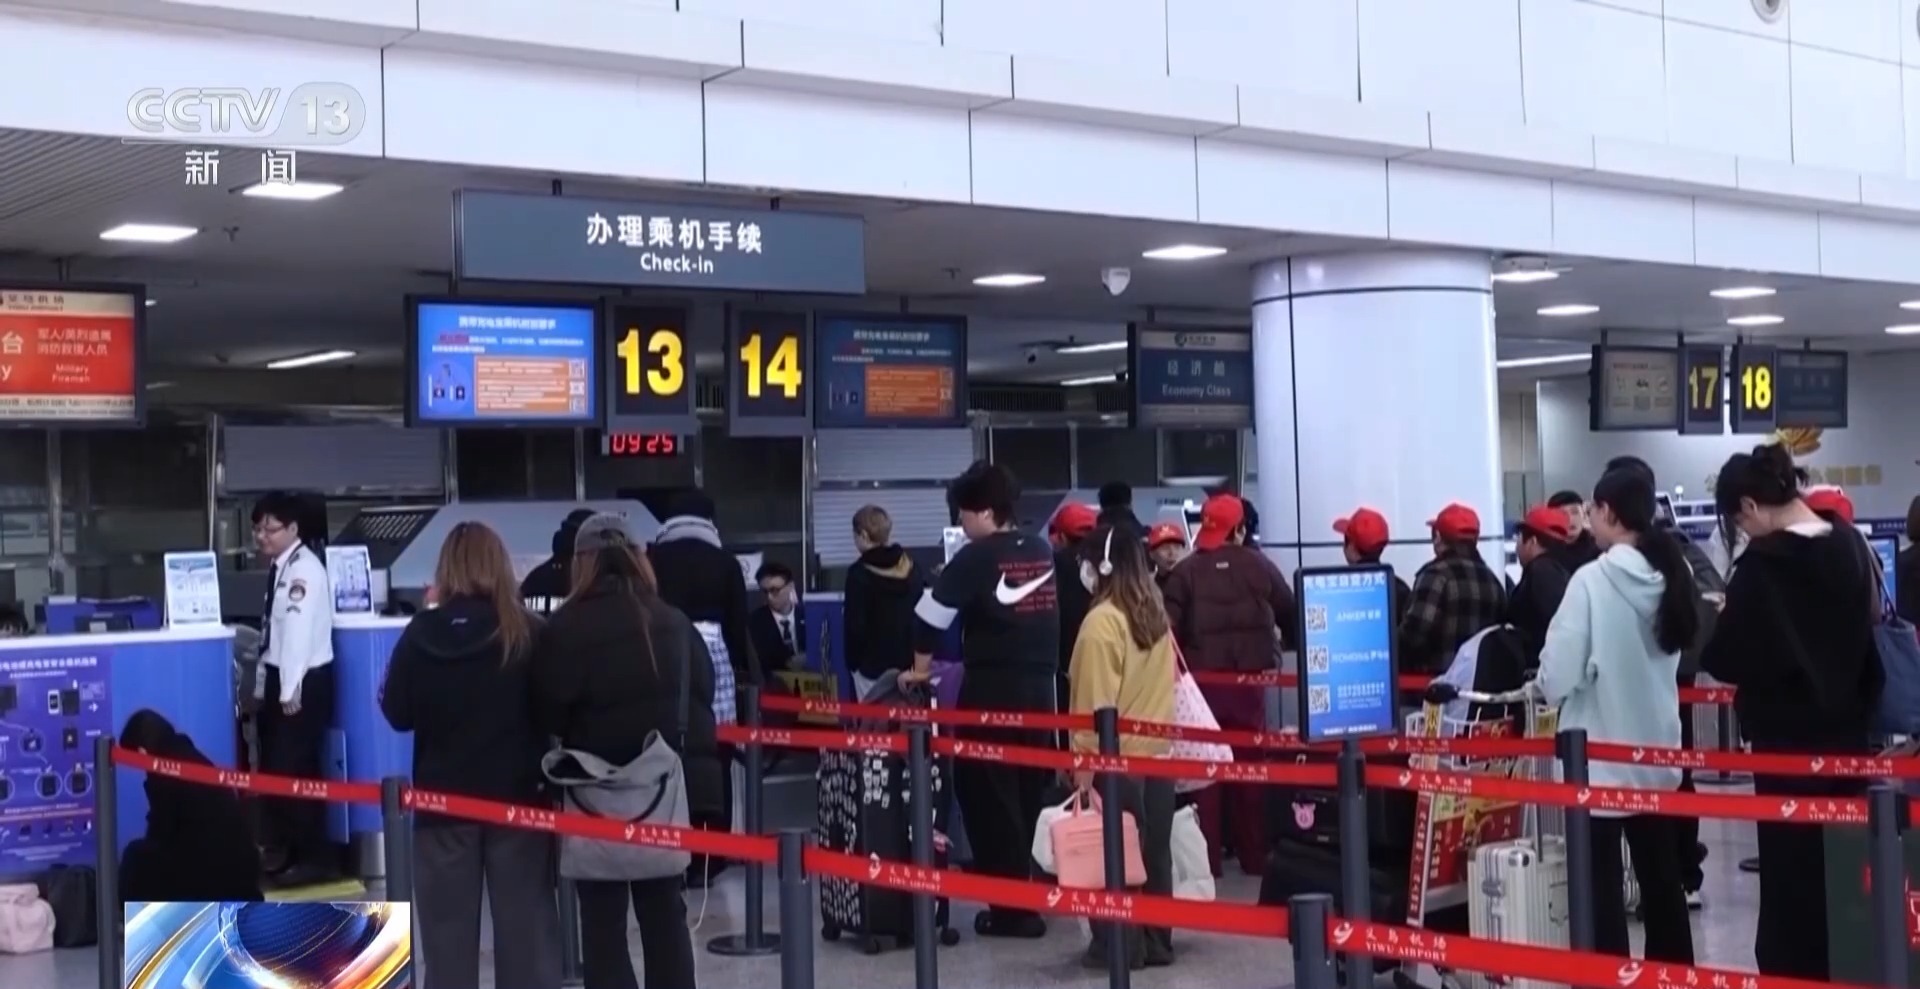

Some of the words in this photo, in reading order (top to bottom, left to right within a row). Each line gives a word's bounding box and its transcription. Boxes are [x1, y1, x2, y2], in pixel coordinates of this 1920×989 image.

[586, 212, 762, 254] 办理乘机手续
[2, 331, 24, 354] 台
[37, 343, 108, 356] 消防救援人员
[1, 364, 12, 381] y
[55, 363, 89, 376] Military
[617, 328, 685, 396] 13
[740, 333, 803, 398] 14
[1162, 383, 1204, 398] Economy
[1206, 383, 1232, 396] Class
[1688, 366, 1719, 410] 17
[1742, 366, 1772, 410] 18
[1809, 801, 1868, 813] 义乌机
[1836, 813, 1868, 823] AIRPO
[1071, 890, 1133, 909] 义乌机场
[1071, 904, 1093, 914] YIWU
[1095, 906, 1133, 919] AIRPORT
[1366, 926, 1447, 950] 义乌机场
[1365, 940, 1397, 956] YIWU
[1397, 944, 1447, 962] AIRPORT
[1657, 968, 1758, 989] 义乌机场
